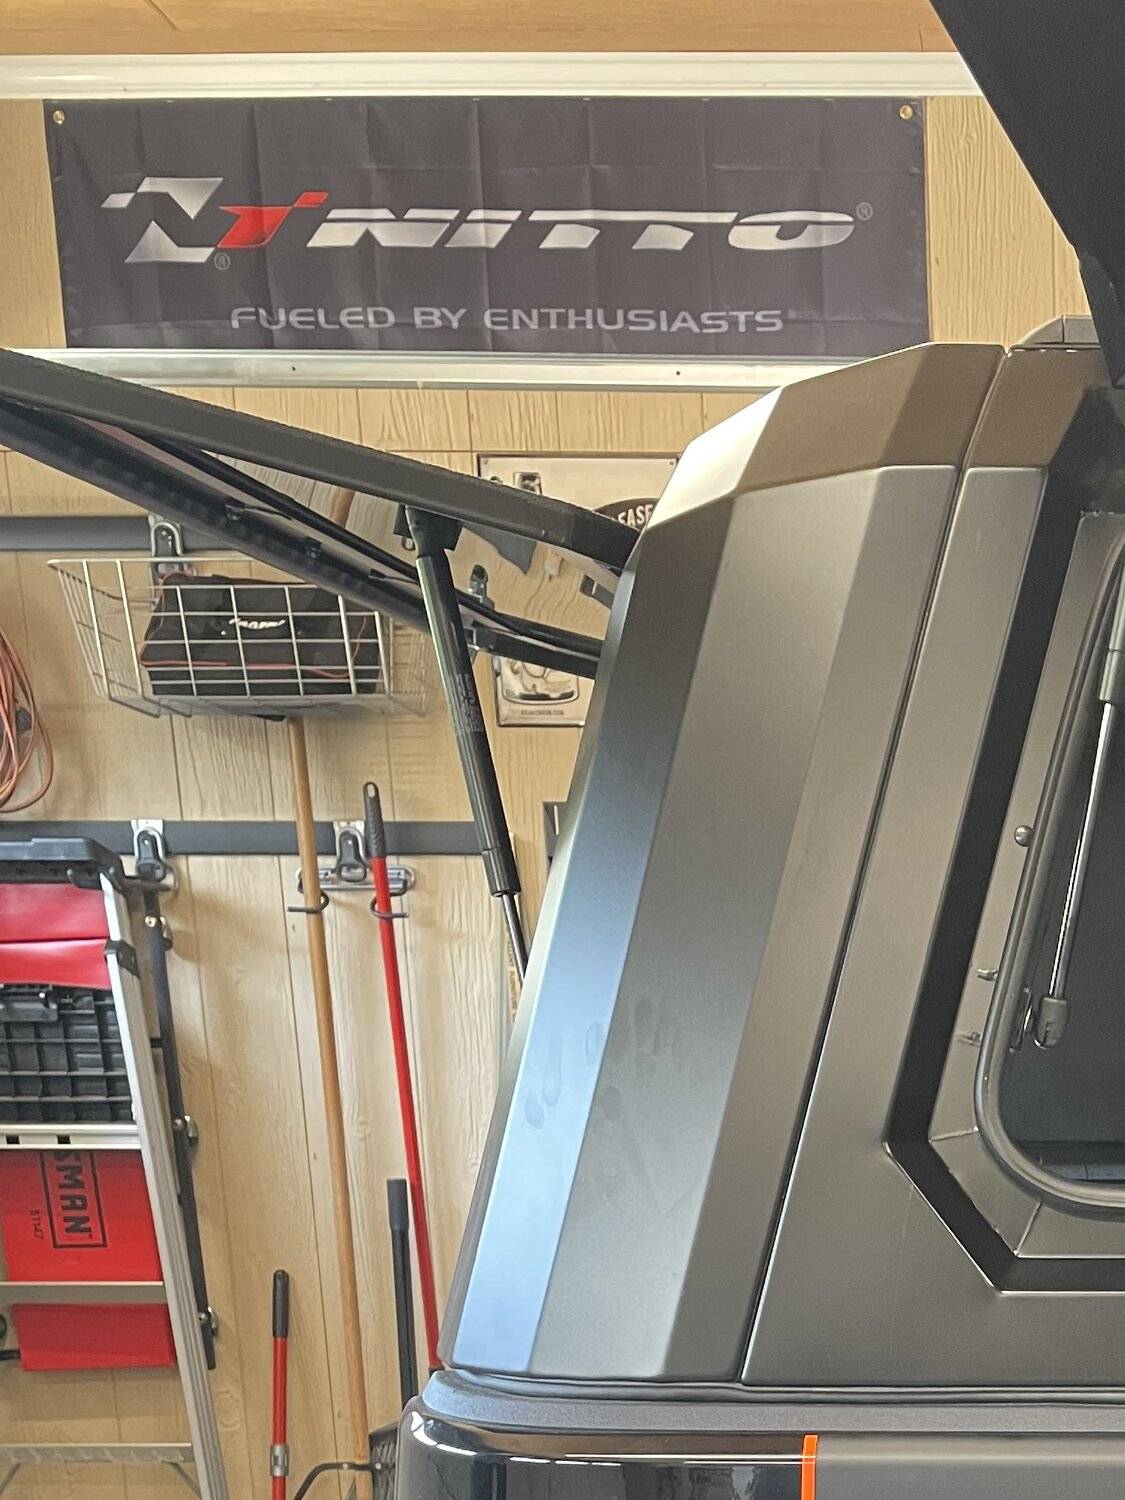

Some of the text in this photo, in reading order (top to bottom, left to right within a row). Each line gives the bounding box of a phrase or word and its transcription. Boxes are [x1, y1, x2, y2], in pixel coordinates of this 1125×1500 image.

[306, 208, 854, 250] NITTO
[231, 306, 783, 333] FUELED BY ENTHUSIASTS
